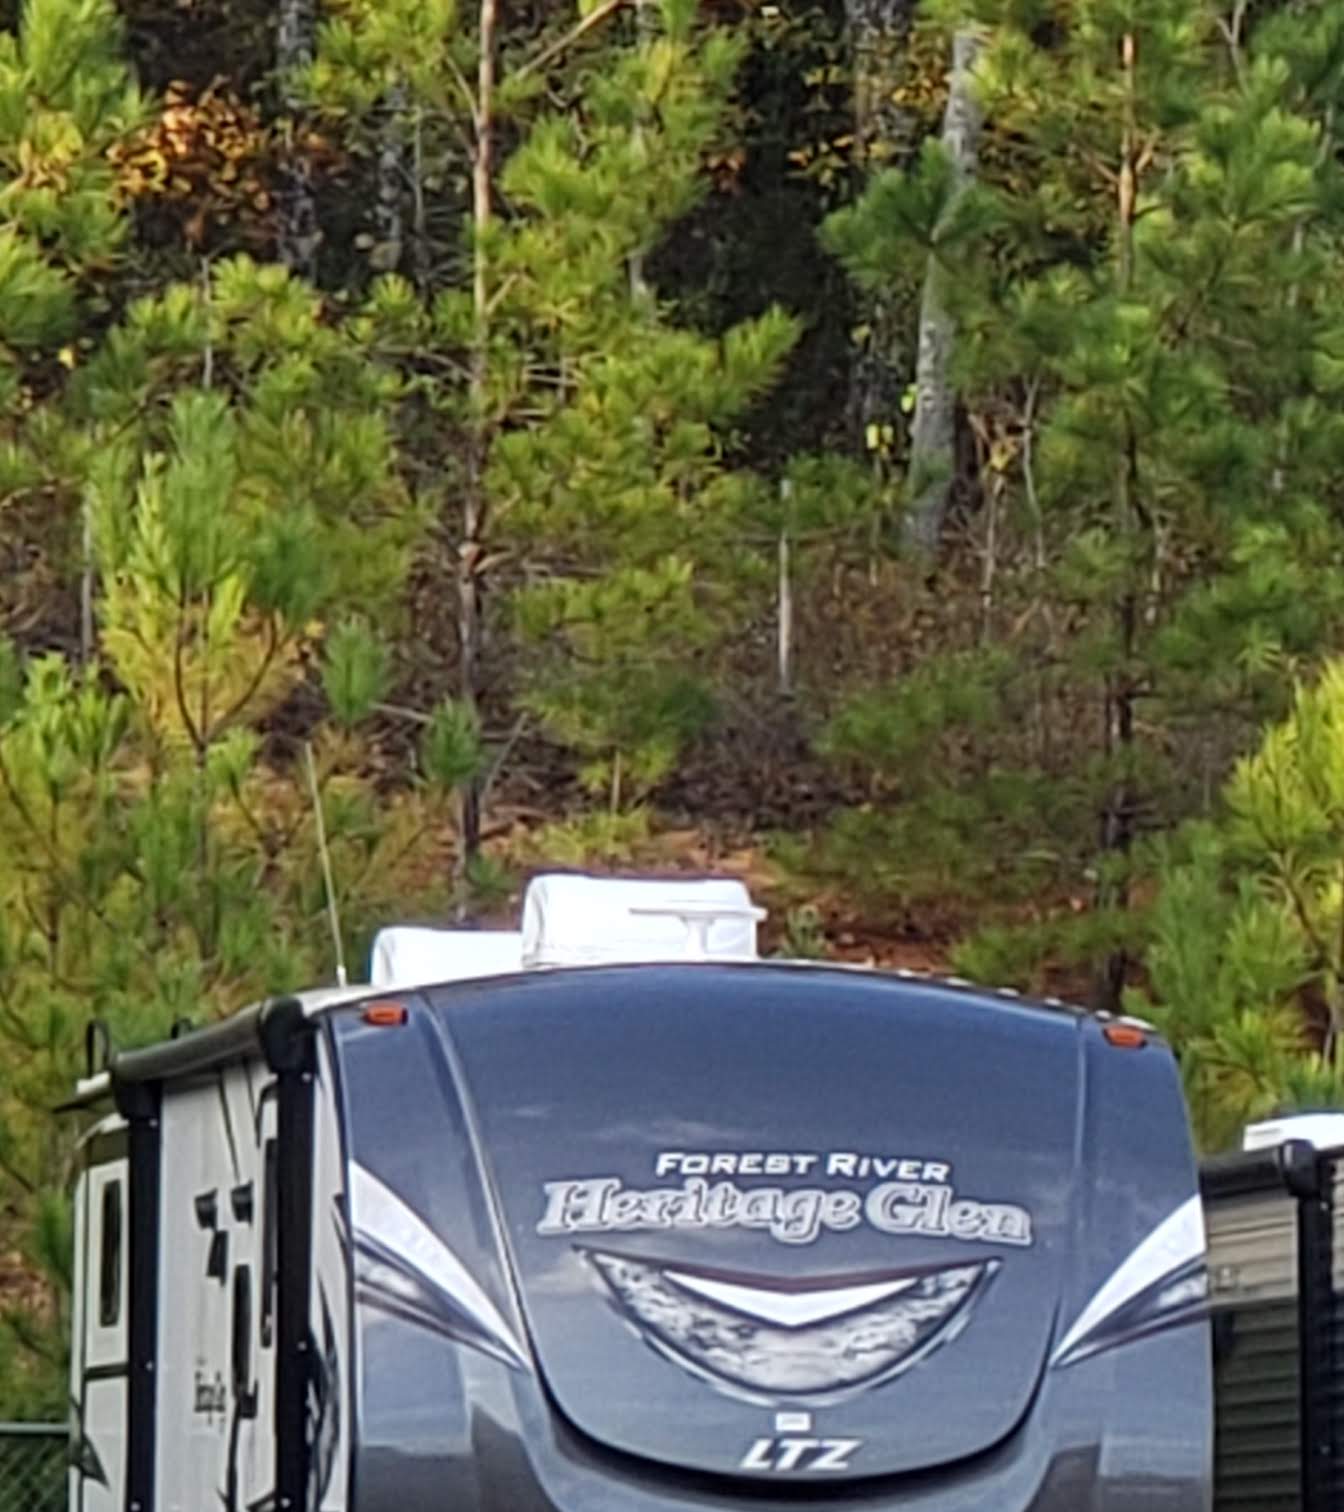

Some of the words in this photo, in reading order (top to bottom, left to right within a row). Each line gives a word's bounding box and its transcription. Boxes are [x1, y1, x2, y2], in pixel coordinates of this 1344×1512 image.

[656, 1152, 818, 1177] FOREST
[827, 1153, 951, 1182] RIVER
[537, 1177, 861, 1243] Heritage
[865, 1182, 1033, 1245] Glen
[740, 1438, 862, 1471] LTZ
